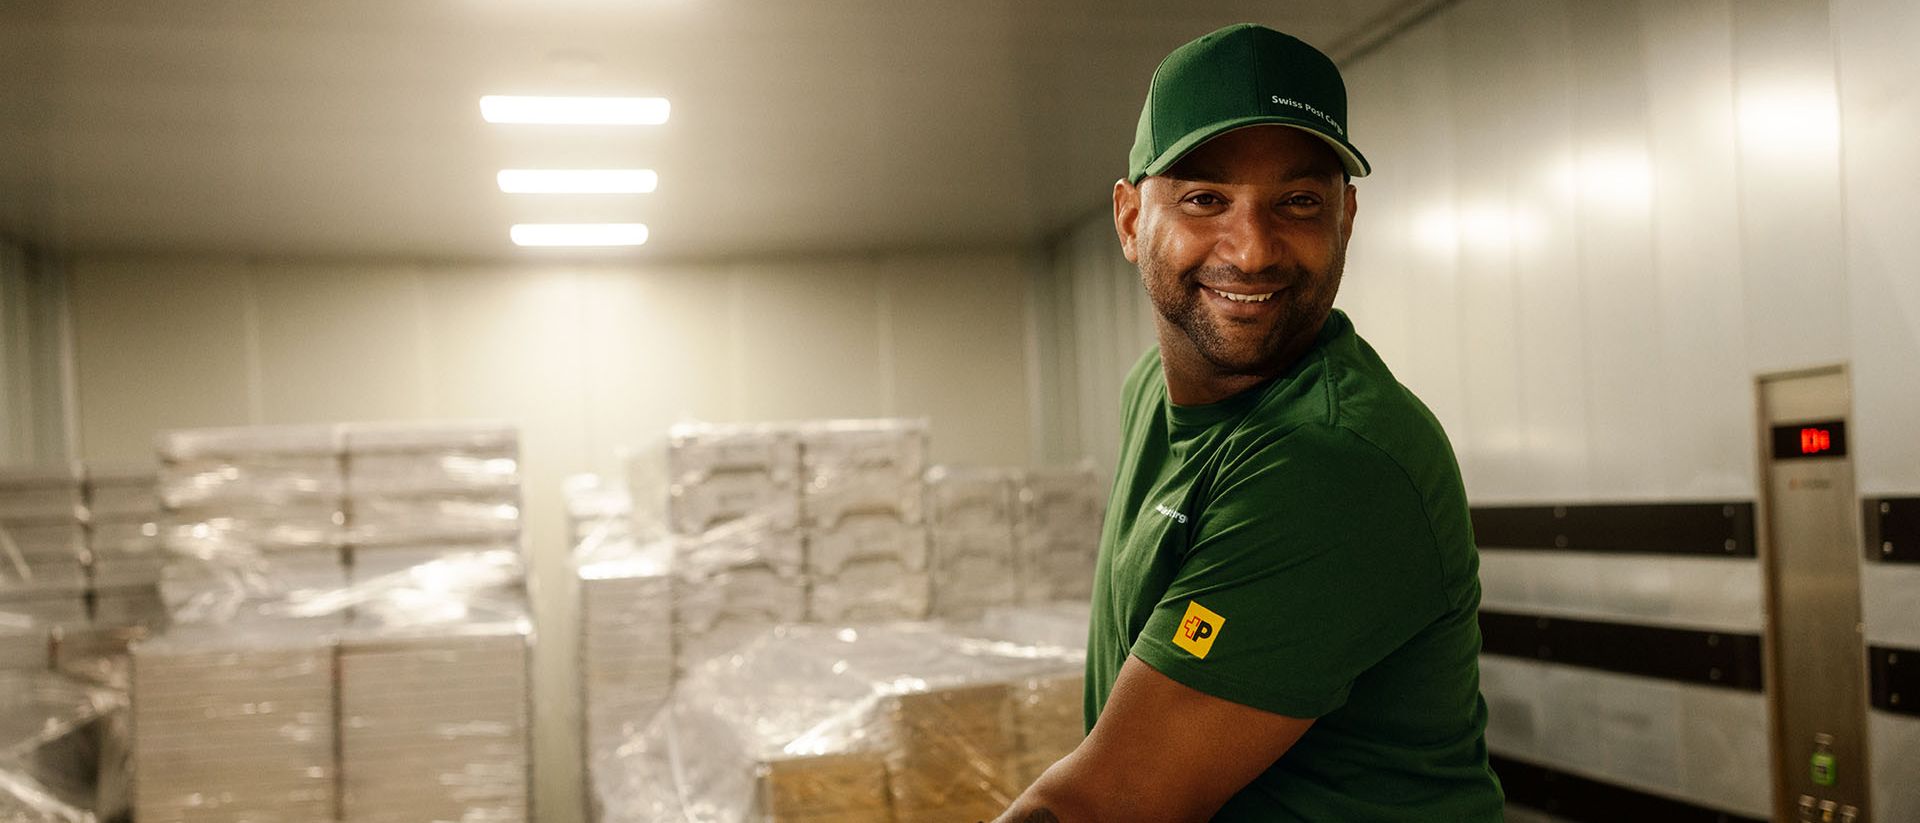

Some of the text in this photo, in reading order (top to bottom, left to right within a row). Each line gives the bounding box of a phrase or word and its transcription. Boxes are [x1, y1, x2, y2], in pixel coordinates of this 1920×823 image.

[1271, 95, 1303, 109] Swiss
[1304, 103, 1325, 119] Post
[1192, 620, 1213, 642] P
